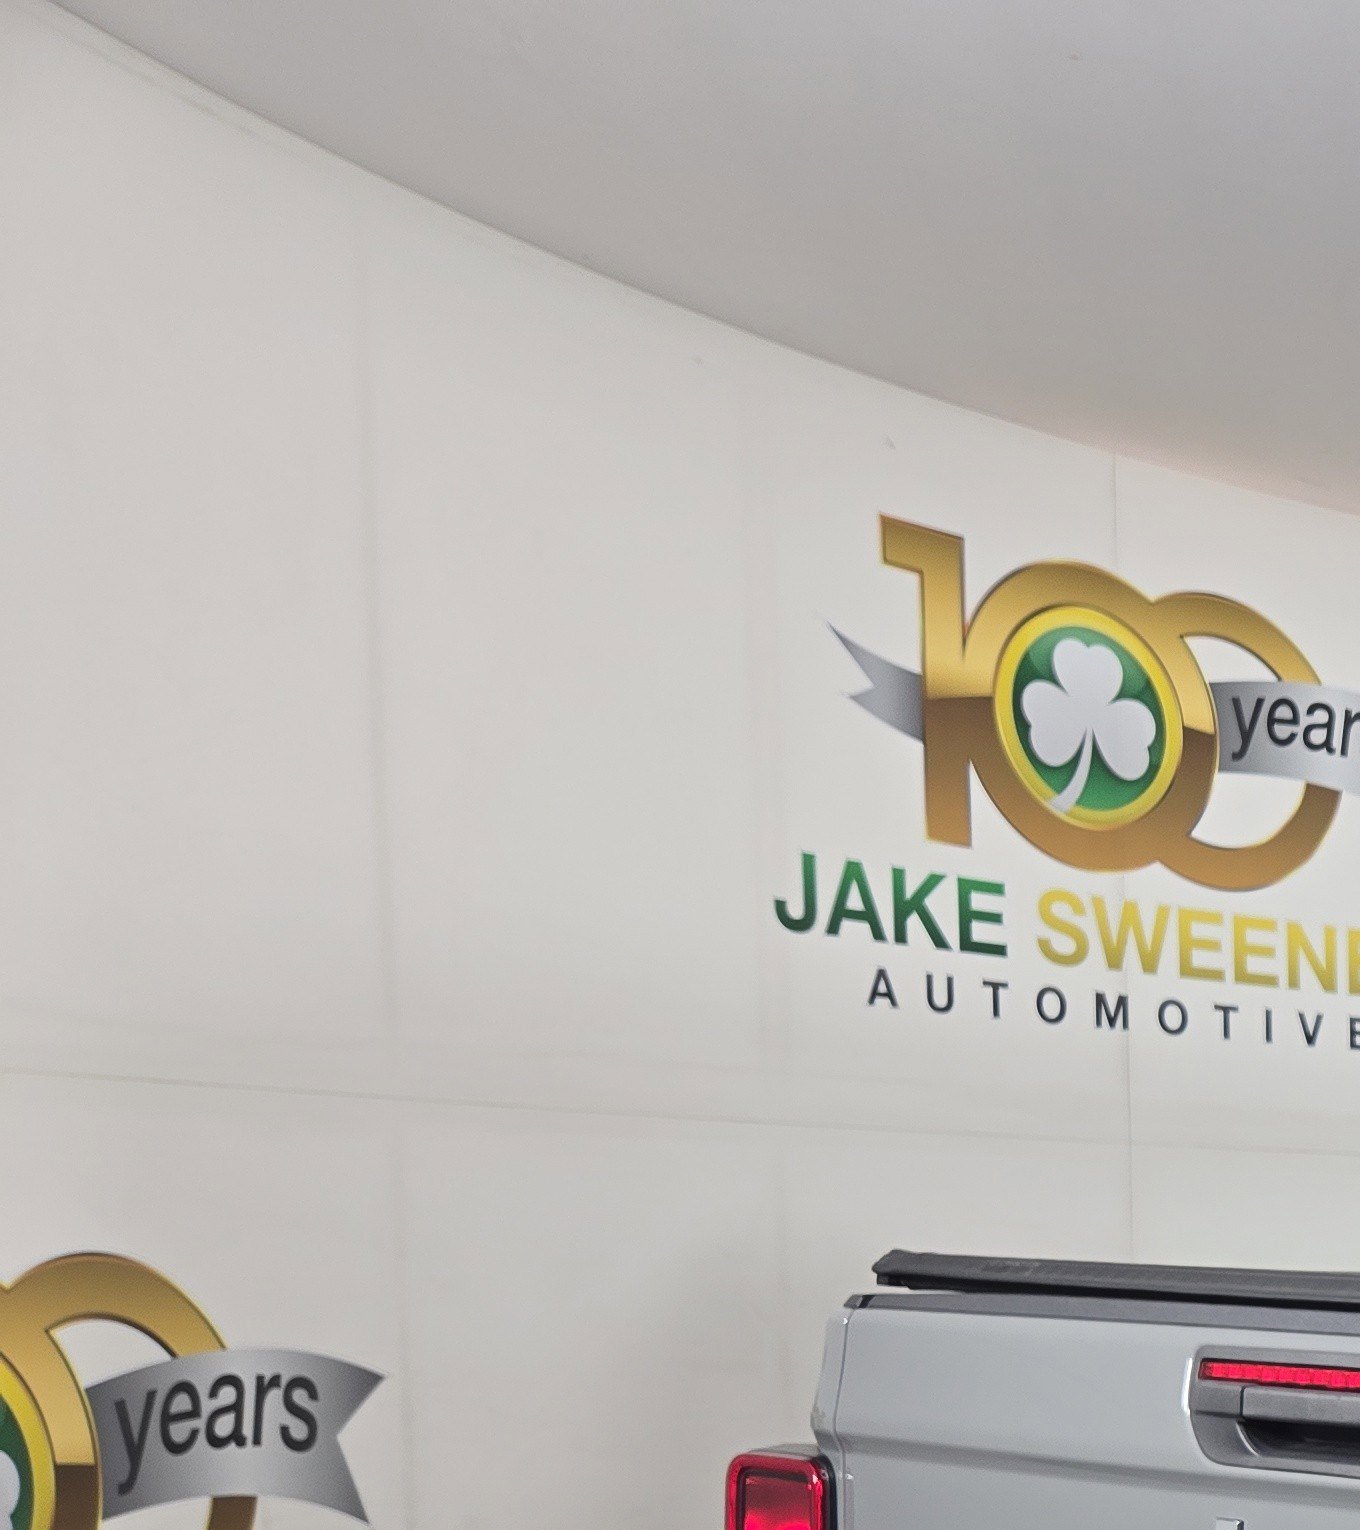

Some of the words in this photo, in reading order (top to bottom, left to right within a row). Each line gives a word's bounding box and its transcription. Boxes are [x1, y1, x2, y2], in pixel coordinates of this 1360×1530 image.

[877, 512, 1343, 893] 100
[773, 850, 1008, 958] JAKE
[113, 1372, 321, 1496] years
